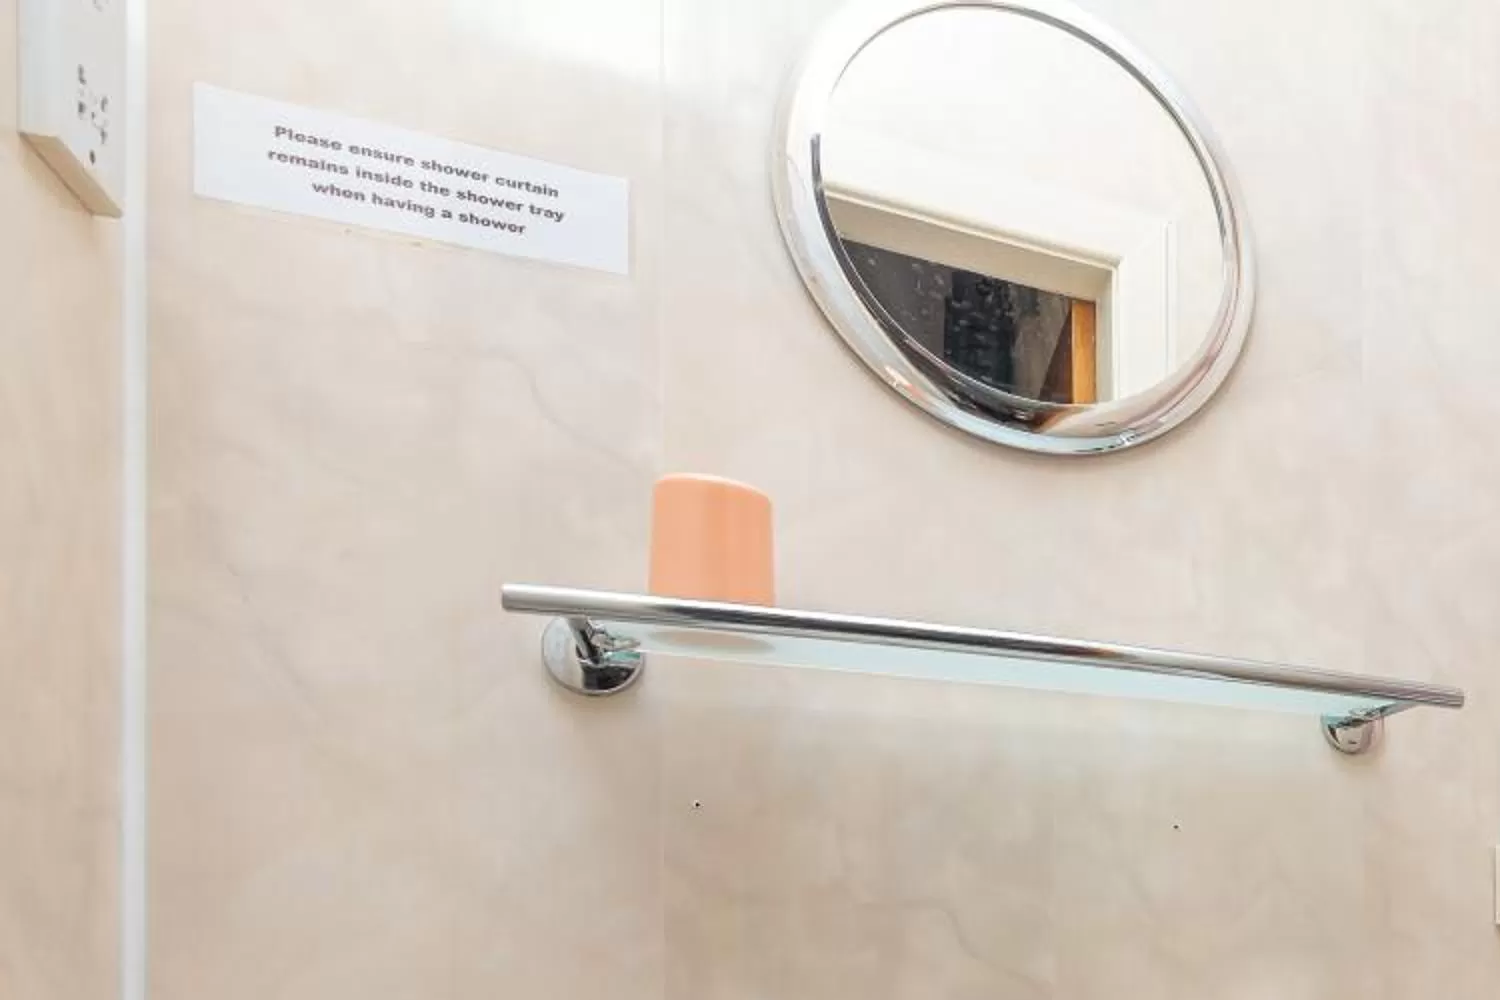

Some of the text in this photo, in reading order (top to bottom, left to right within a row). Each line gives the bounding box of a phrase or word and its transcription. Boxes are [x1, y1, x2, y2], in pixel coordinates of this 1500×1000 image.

[268, 150, 565, 223] remains inside the shower tray
[274, 125, 559, 198] Please ensure shower curtain
[312, 181, 527, 234] when having a shower
